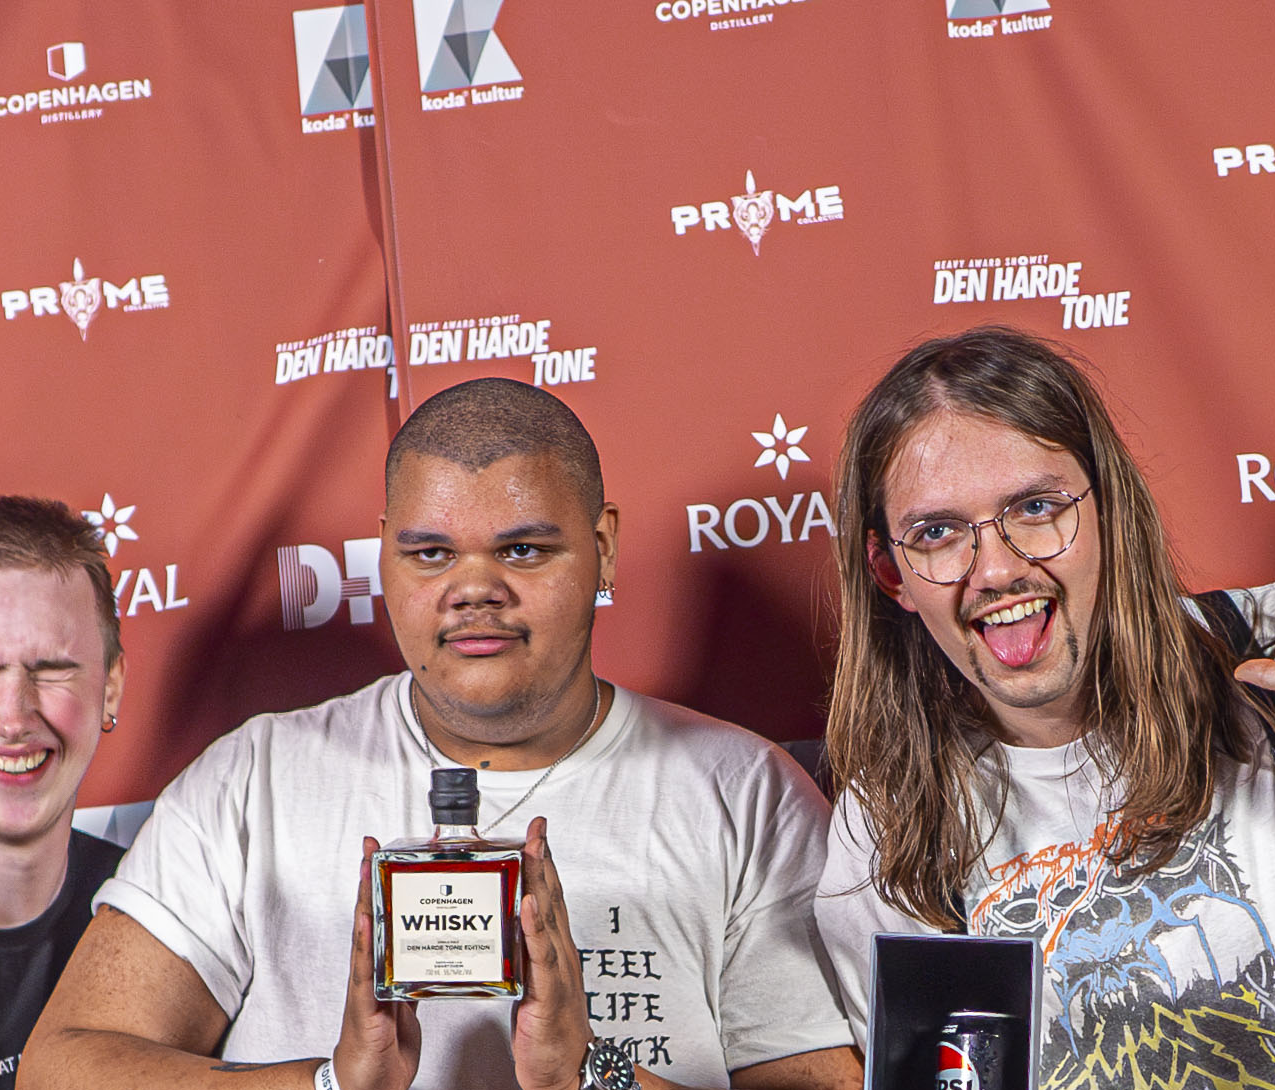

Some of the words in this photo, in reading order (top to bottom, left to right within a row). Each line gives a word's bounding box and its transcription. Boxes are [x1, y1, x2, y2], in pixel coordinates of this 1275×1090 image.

[710, 13, 773, 31] DISTILLERY
[40, 108, 103, 125] DISTILLERY
[933, 268, 988, 305] DEN
[1060, 290, 1131, 330] TONE
[275, 345, 322, 385] DEN
[409, 328, 463, 366] DEN
[531, 346, 597, 387] TONE
[686, 491, 838, 554] ROYA
[401, 914, 494, 931] WHISKY
[578, 949, 662, 980] FEEL
[586, 992, 664, 1022] LIFE
